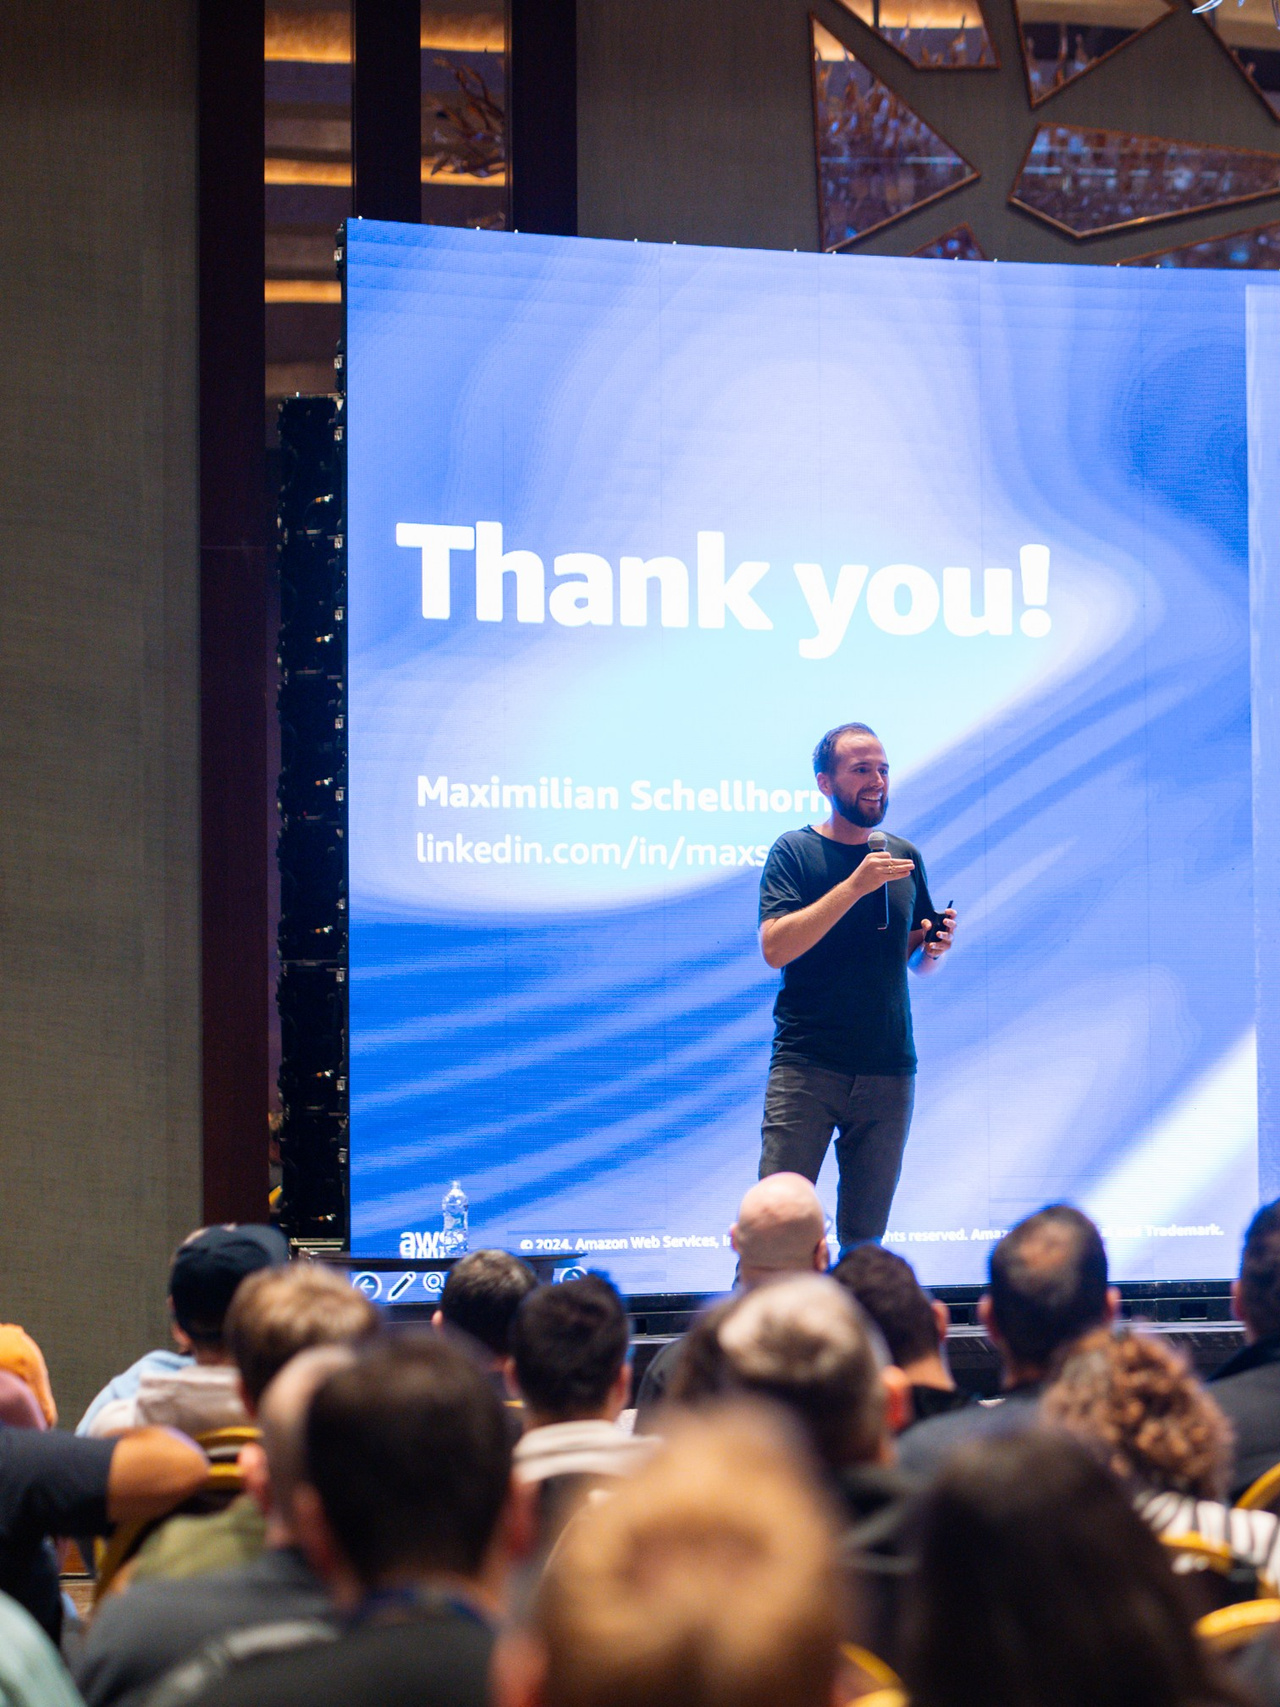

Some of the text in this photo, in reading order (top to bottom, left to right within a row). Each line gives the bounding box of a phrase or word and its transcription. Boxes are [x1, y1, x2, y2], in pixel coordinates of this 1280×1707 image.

[396, 521, 1051, 659] Thank you!
[417, 775, 832, 813] Maximilian Schellhorn
[417, 832, 769, 870] linkedin.com/in/maxs
[535, 1238, 573, 1250] 2024.
[575, 1237, 628, 1250] Amazon
[629, 1236, 660, 1249] Web
[663, 1235, 719, 1248] Services,
[908, 1229, 967, 1242] reserved.
[1146, 1224, 1225, 1237] Trademark.
